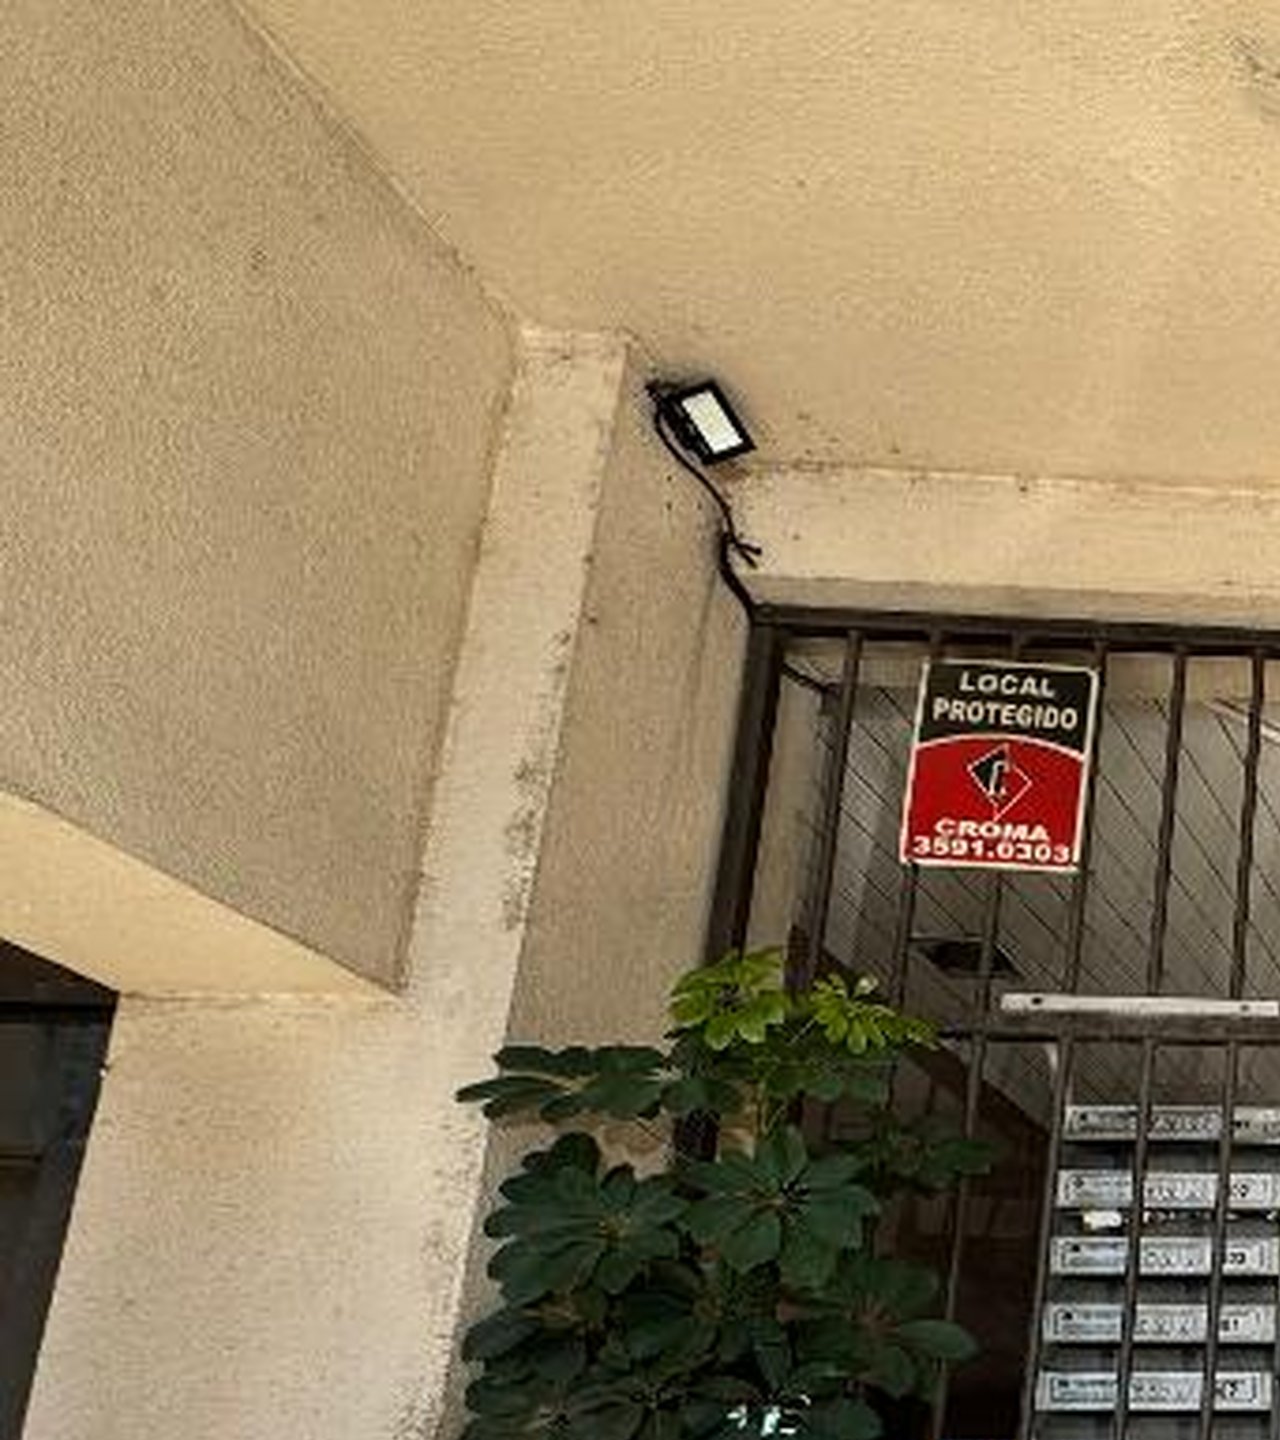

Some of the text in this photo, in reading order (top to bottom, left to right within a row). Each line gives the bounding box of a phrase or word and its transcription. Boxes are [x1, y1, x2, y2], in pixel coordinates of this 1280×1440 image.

[959, 672, 1055, 698] LOCAL
[932, 697, 1078, 730] PROTEGIDO
[934, 817, 1050, 841] CROMA
[912, 835, 1071, 863] 3591.0303
